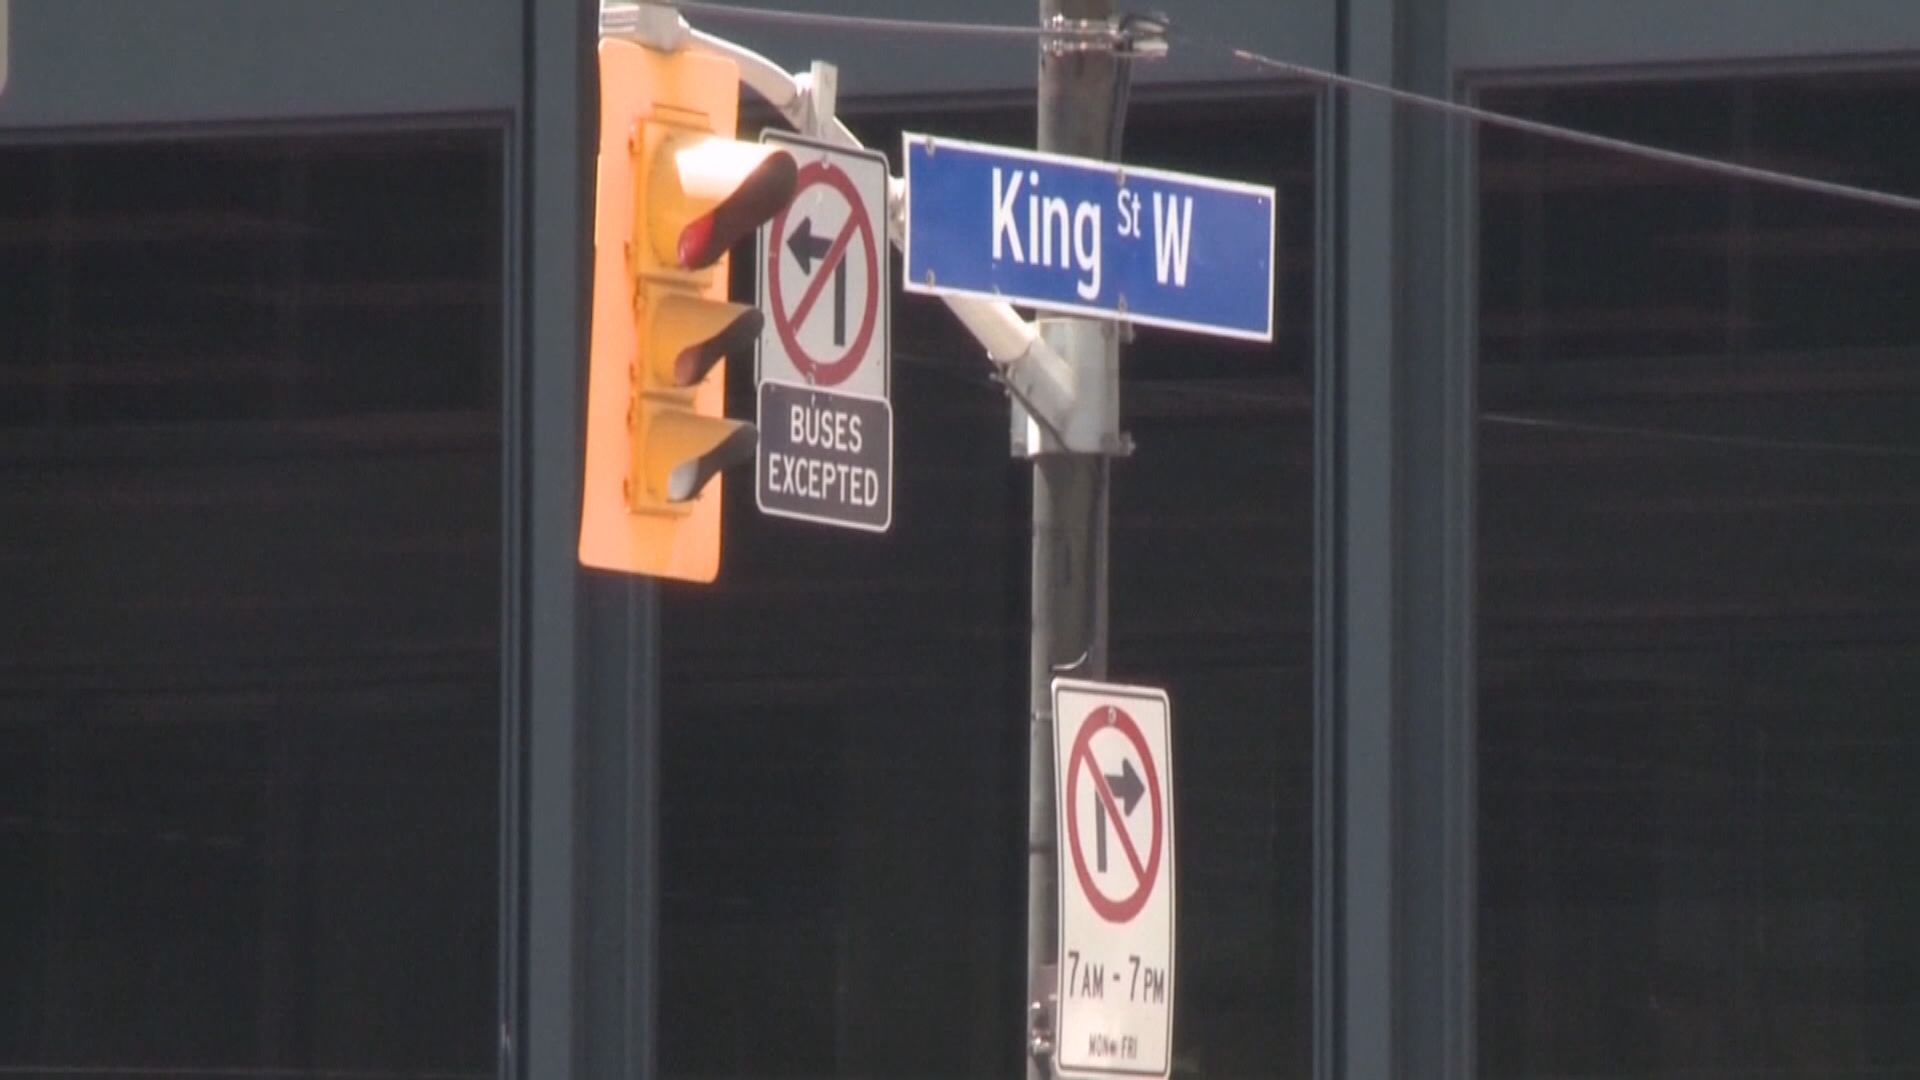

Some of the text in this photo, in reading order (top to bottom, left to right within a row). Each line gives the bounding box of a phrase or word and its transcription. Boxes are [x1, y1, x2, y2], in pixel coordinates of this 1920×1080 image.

[992, 167, 1194, 301] King St W
[790, 403, 863, 455] BUSES
[768, 451, 880, 507] EXCEPTED
